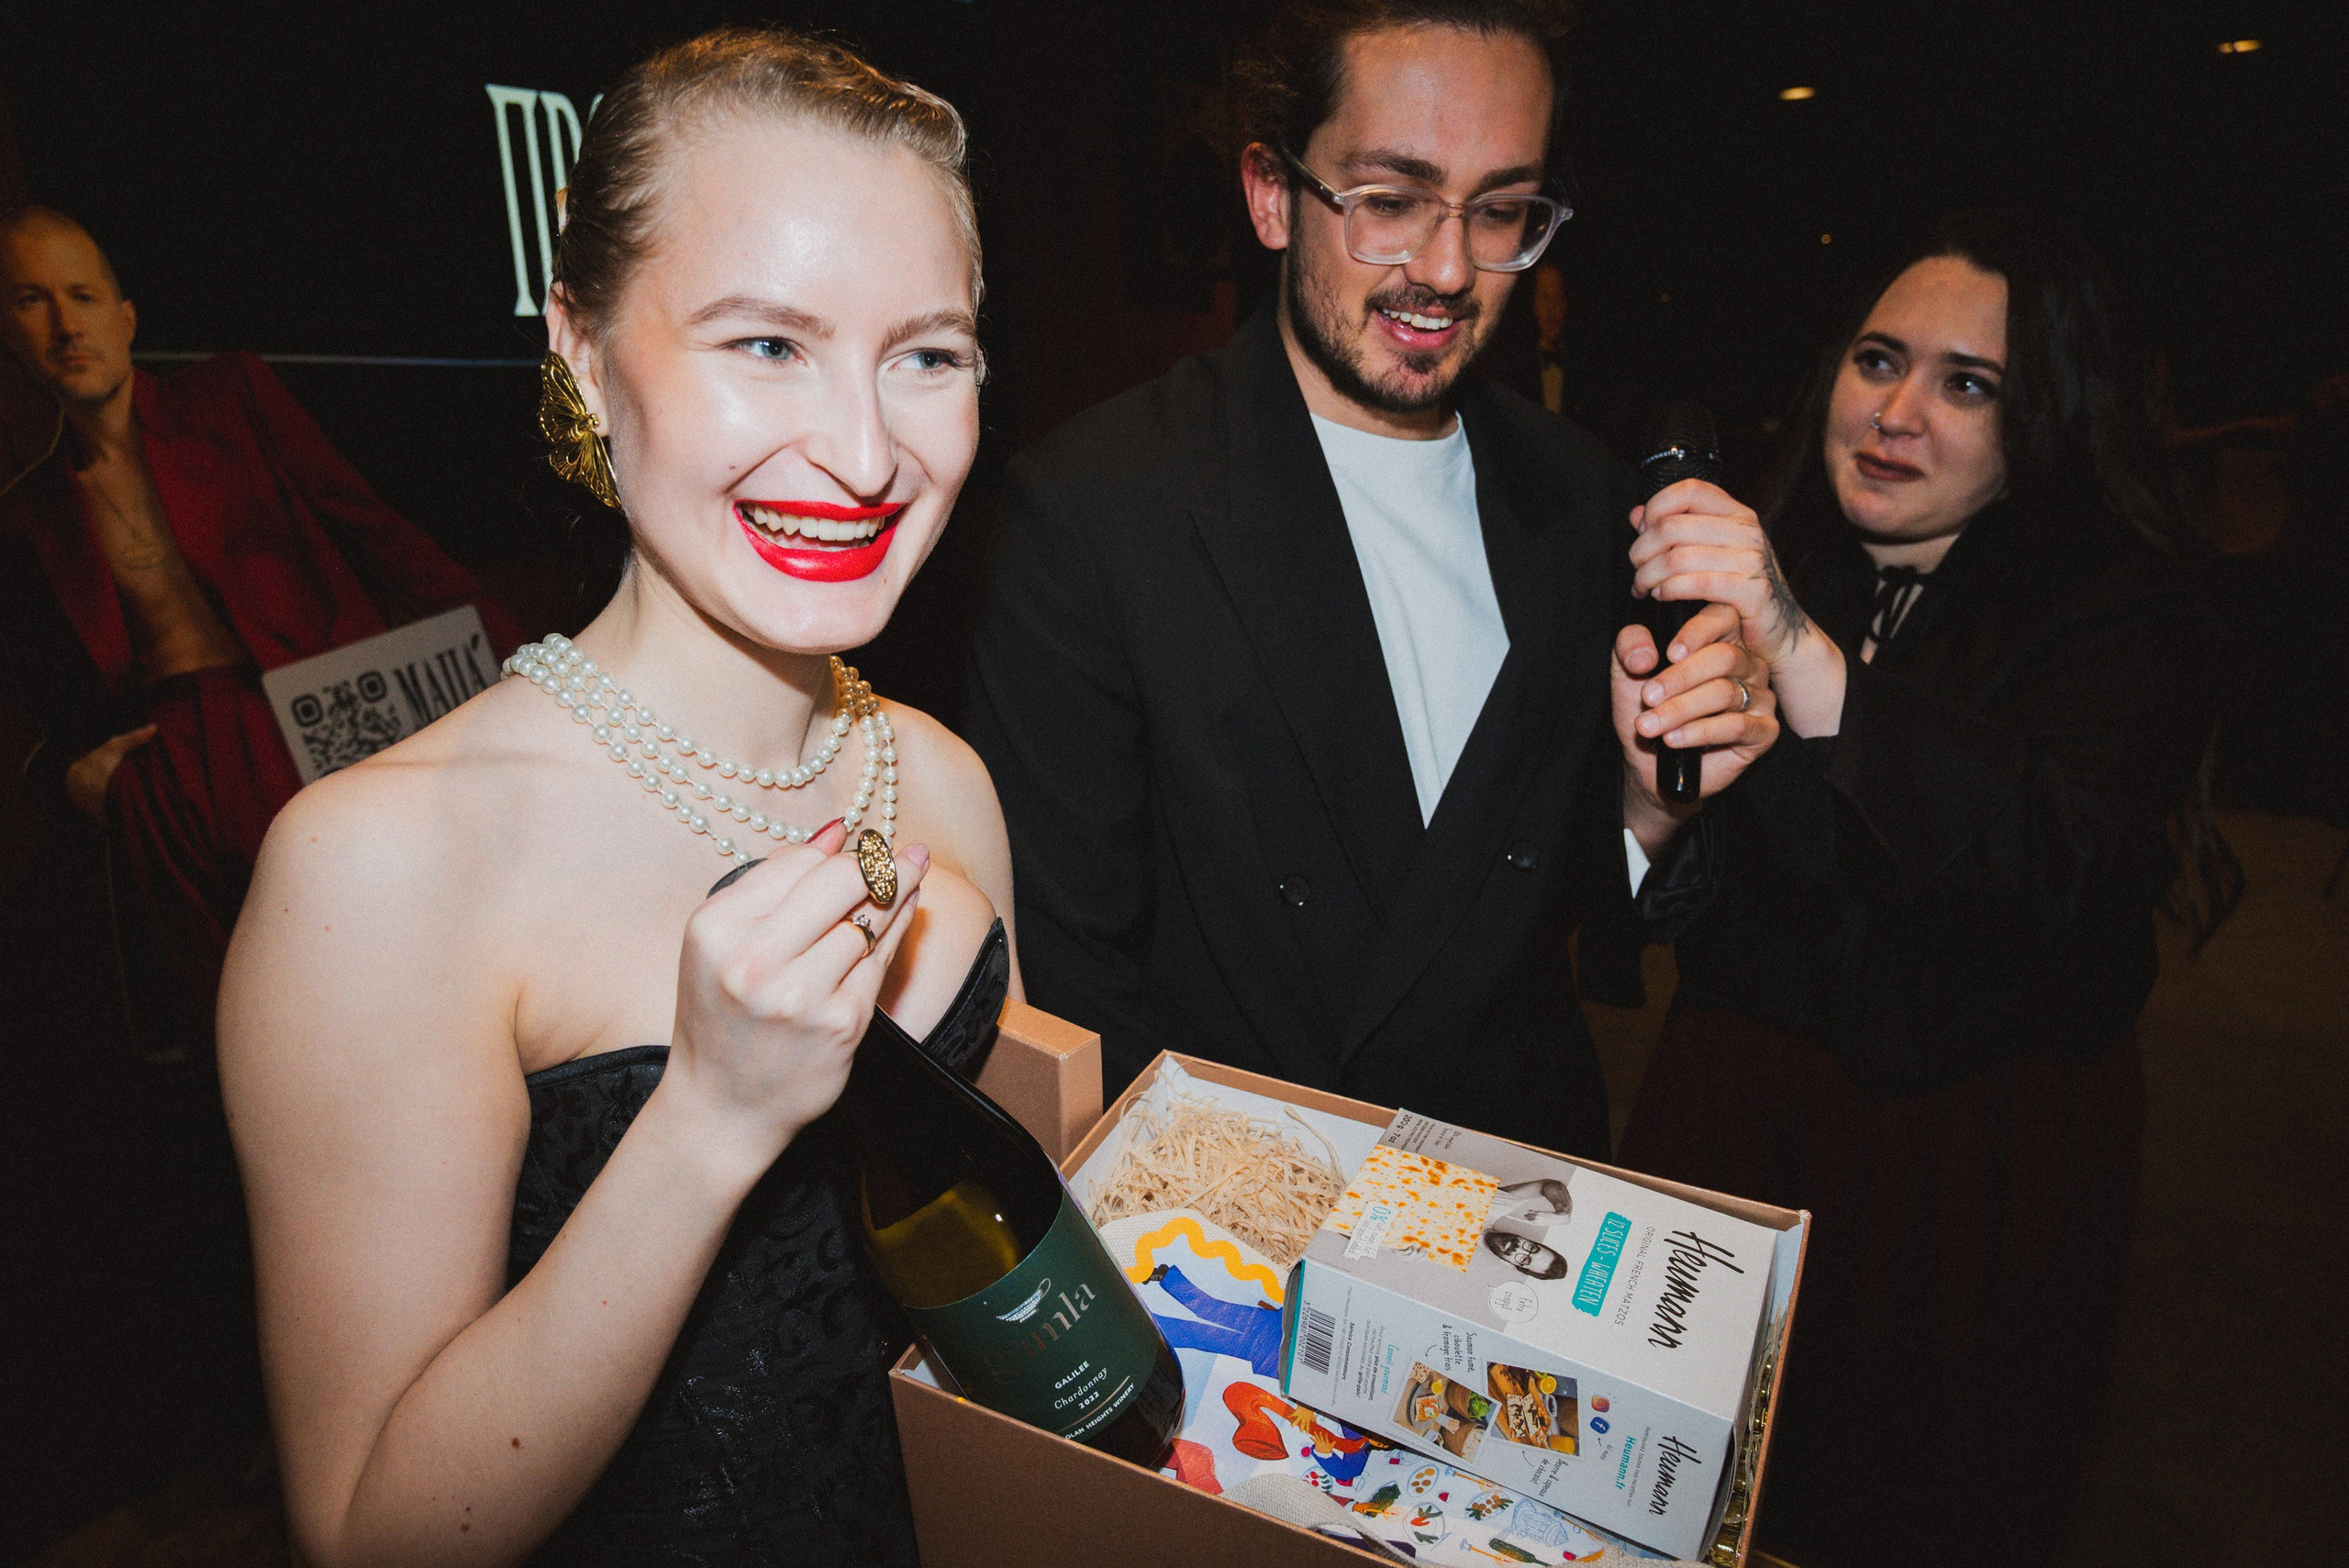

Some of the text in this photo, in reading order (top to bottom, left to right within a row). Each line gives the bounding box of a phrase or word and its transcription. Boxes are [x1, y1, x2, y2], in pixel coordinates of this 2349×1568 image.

[1370, 1207, 1391, 1223] 0%
[1607, 1218, 1626, 1229] 12
[1597, 1228, 1623, 1257] SLICES
[1577, 1261, 1610, 1306] WHEATEN
[1614, 1226, 1655, 1326] ORIGINAL FRENCH MATZOS
[1648, 1230, 1744, 1348] Heumann
[1516, 1297, 1532, 1312] Extra
[1387, 1343, 1398, 1366] Conseil
[1054, 1361, 1090, 1389] GALILEE
[1054, 1366, 1108, 1409] Chardonnay
[1064, 1383, 1135, 1440] OLAN HEIGHTS WINERY
[1078, 1391, 1100, 1409] 2022
[1615, 1436, 1636, 1490] Heumann.fr
[1649, 1436, 1701, 1515] Heumann
